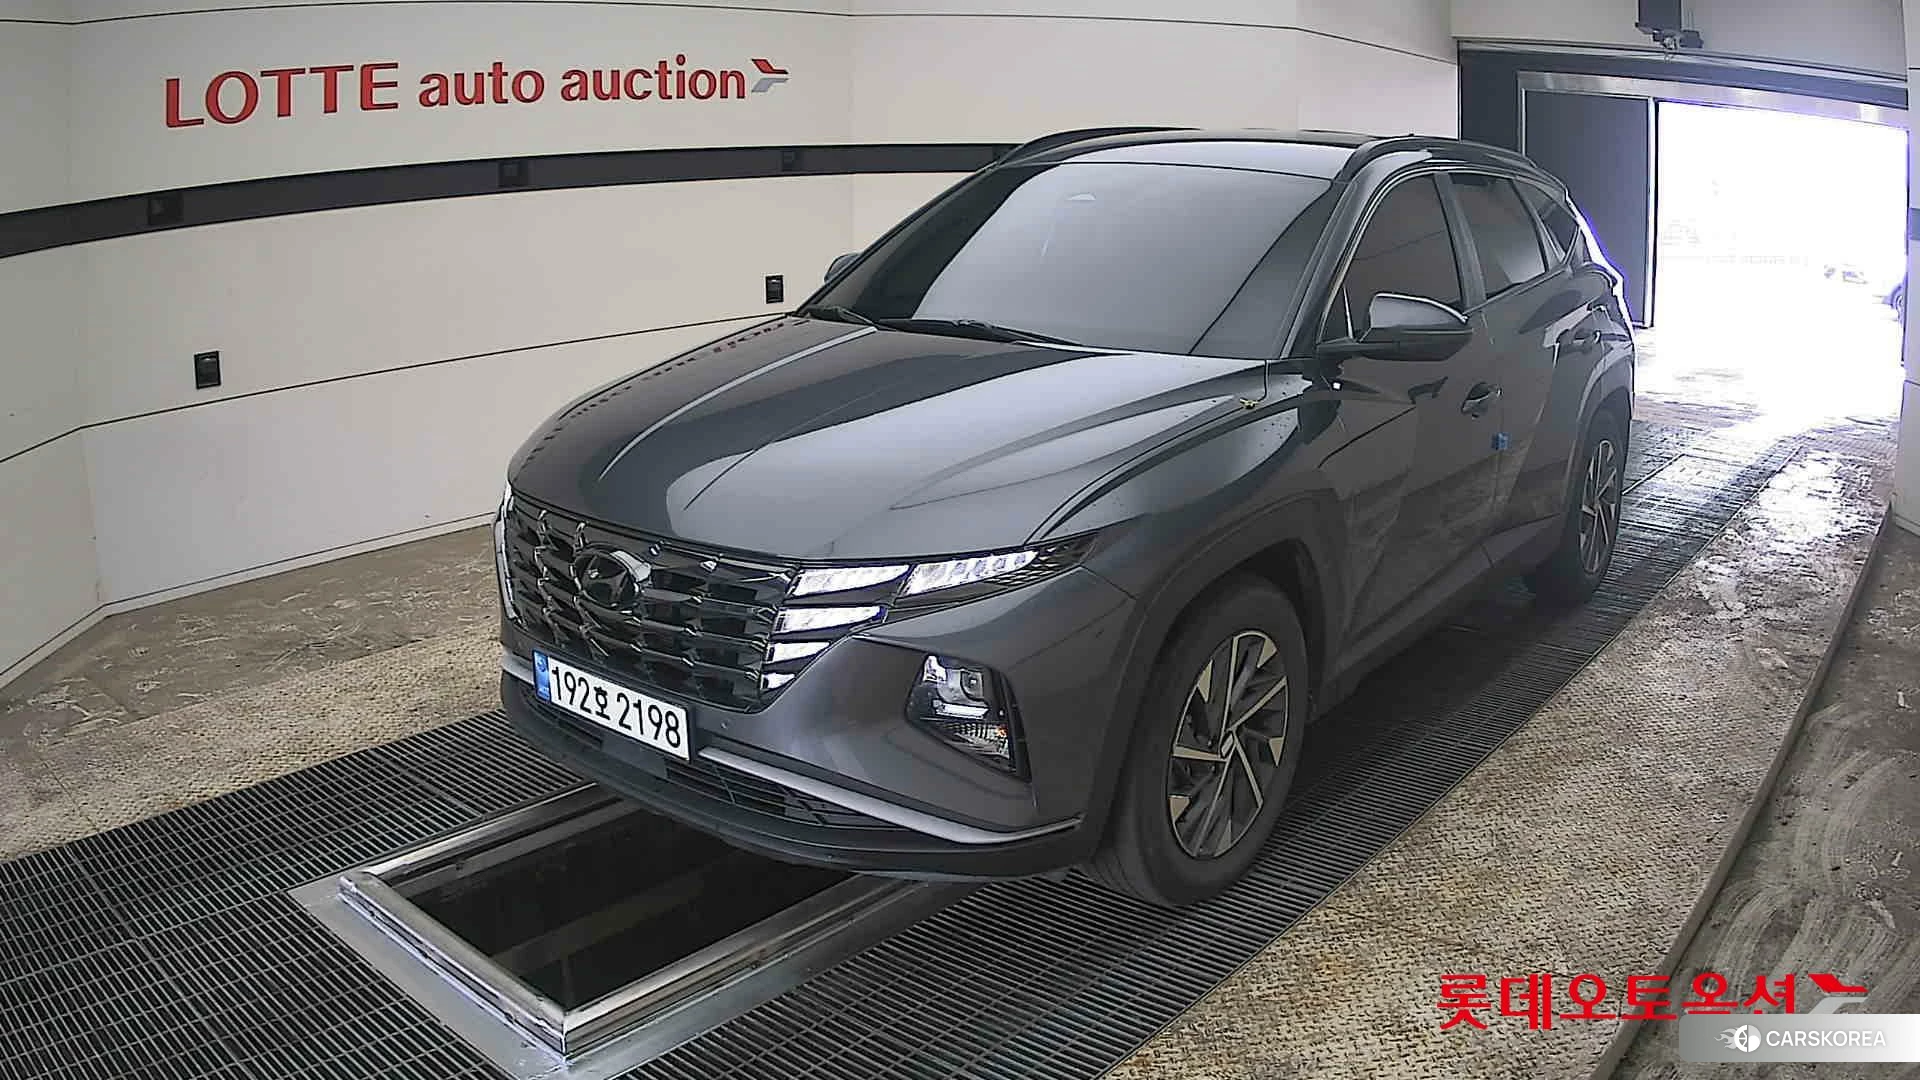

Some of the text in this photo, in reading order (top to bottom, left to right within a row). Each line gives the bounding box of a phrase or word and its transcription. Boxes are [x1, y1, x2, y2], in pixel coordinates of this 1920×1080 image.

[165, 54, 746, 128] LOTTE auto auction
[552, 666, 681, 749] 192호 2198
